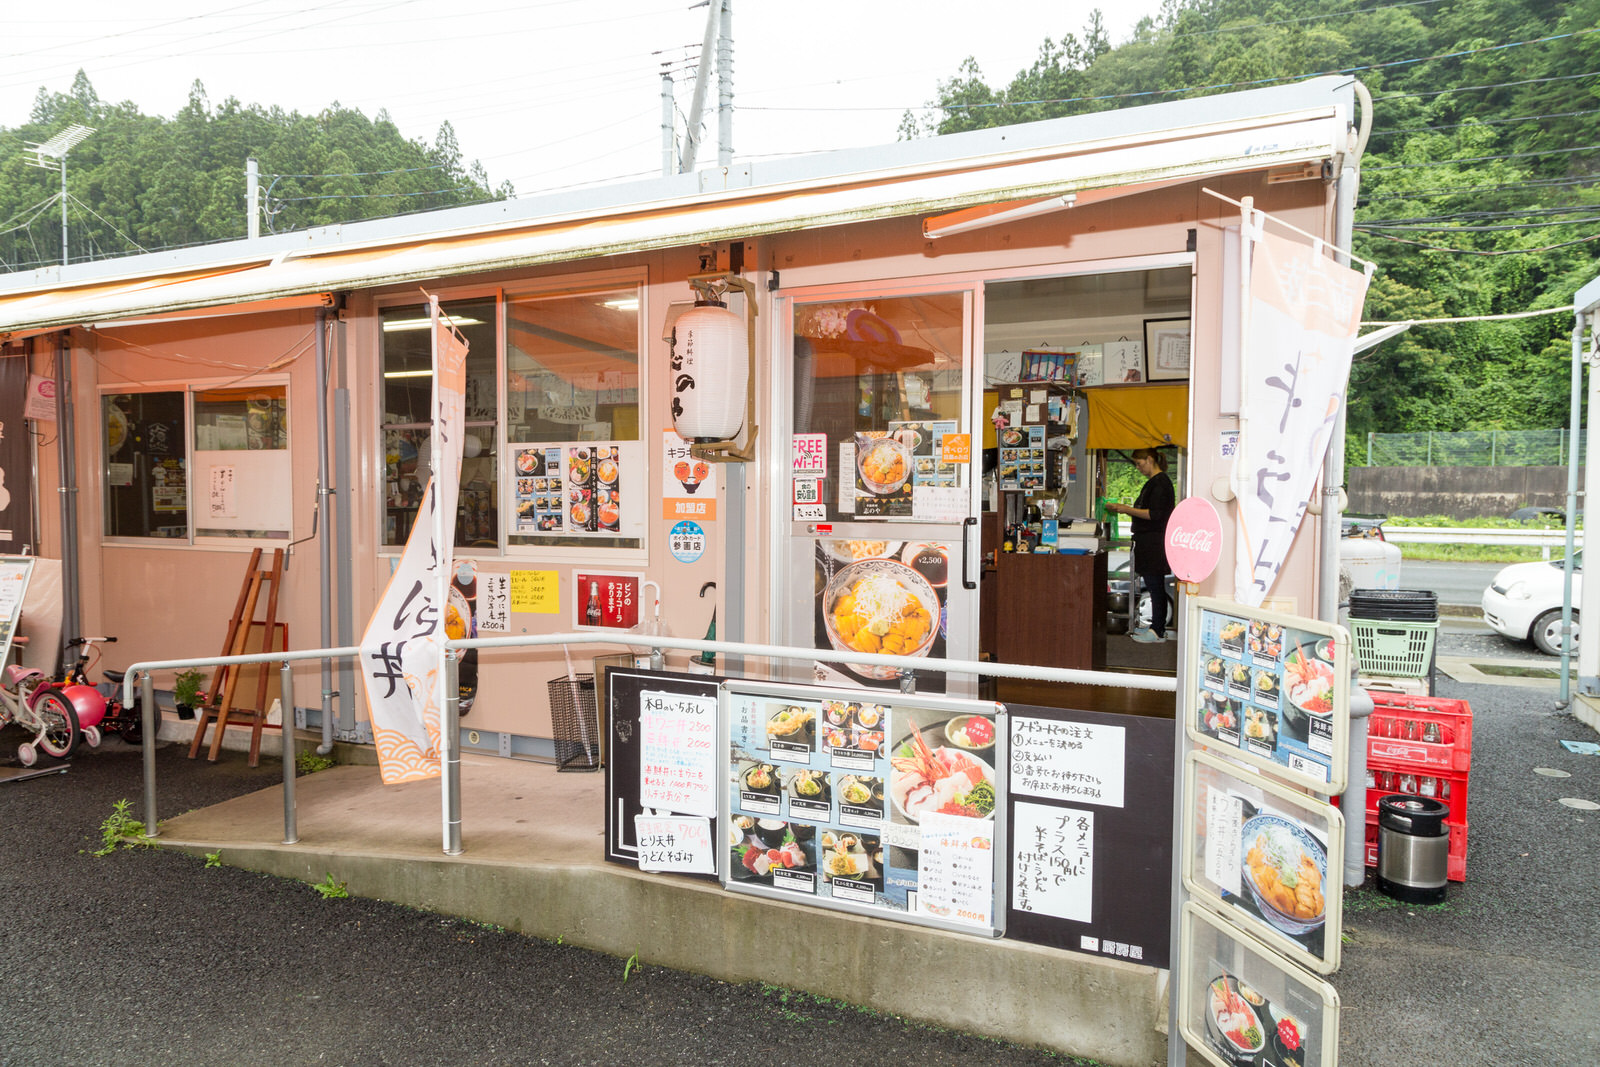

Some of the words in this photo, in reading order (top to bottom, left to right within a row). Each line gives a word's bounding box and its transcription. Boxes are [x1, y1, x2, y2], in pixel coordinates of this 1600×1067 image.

[675, 502, 706, 514] 加盟店
[918, 556, 942, 565] ¥2,500
[624, 582, 632, 606] ビンの
[644, 698, 705, 715] 本日のいちおし
[688, 721, 712, 733] 2500
[1015, 720, 1094, 739] フードコートでの注文
[687, 738, 712, 749] 2000
[640, 834, 676, 848] とり天丼
[1073, 816, 1091, 877] 各メニューに
[640, 849, 694, 864] うどんそば付
